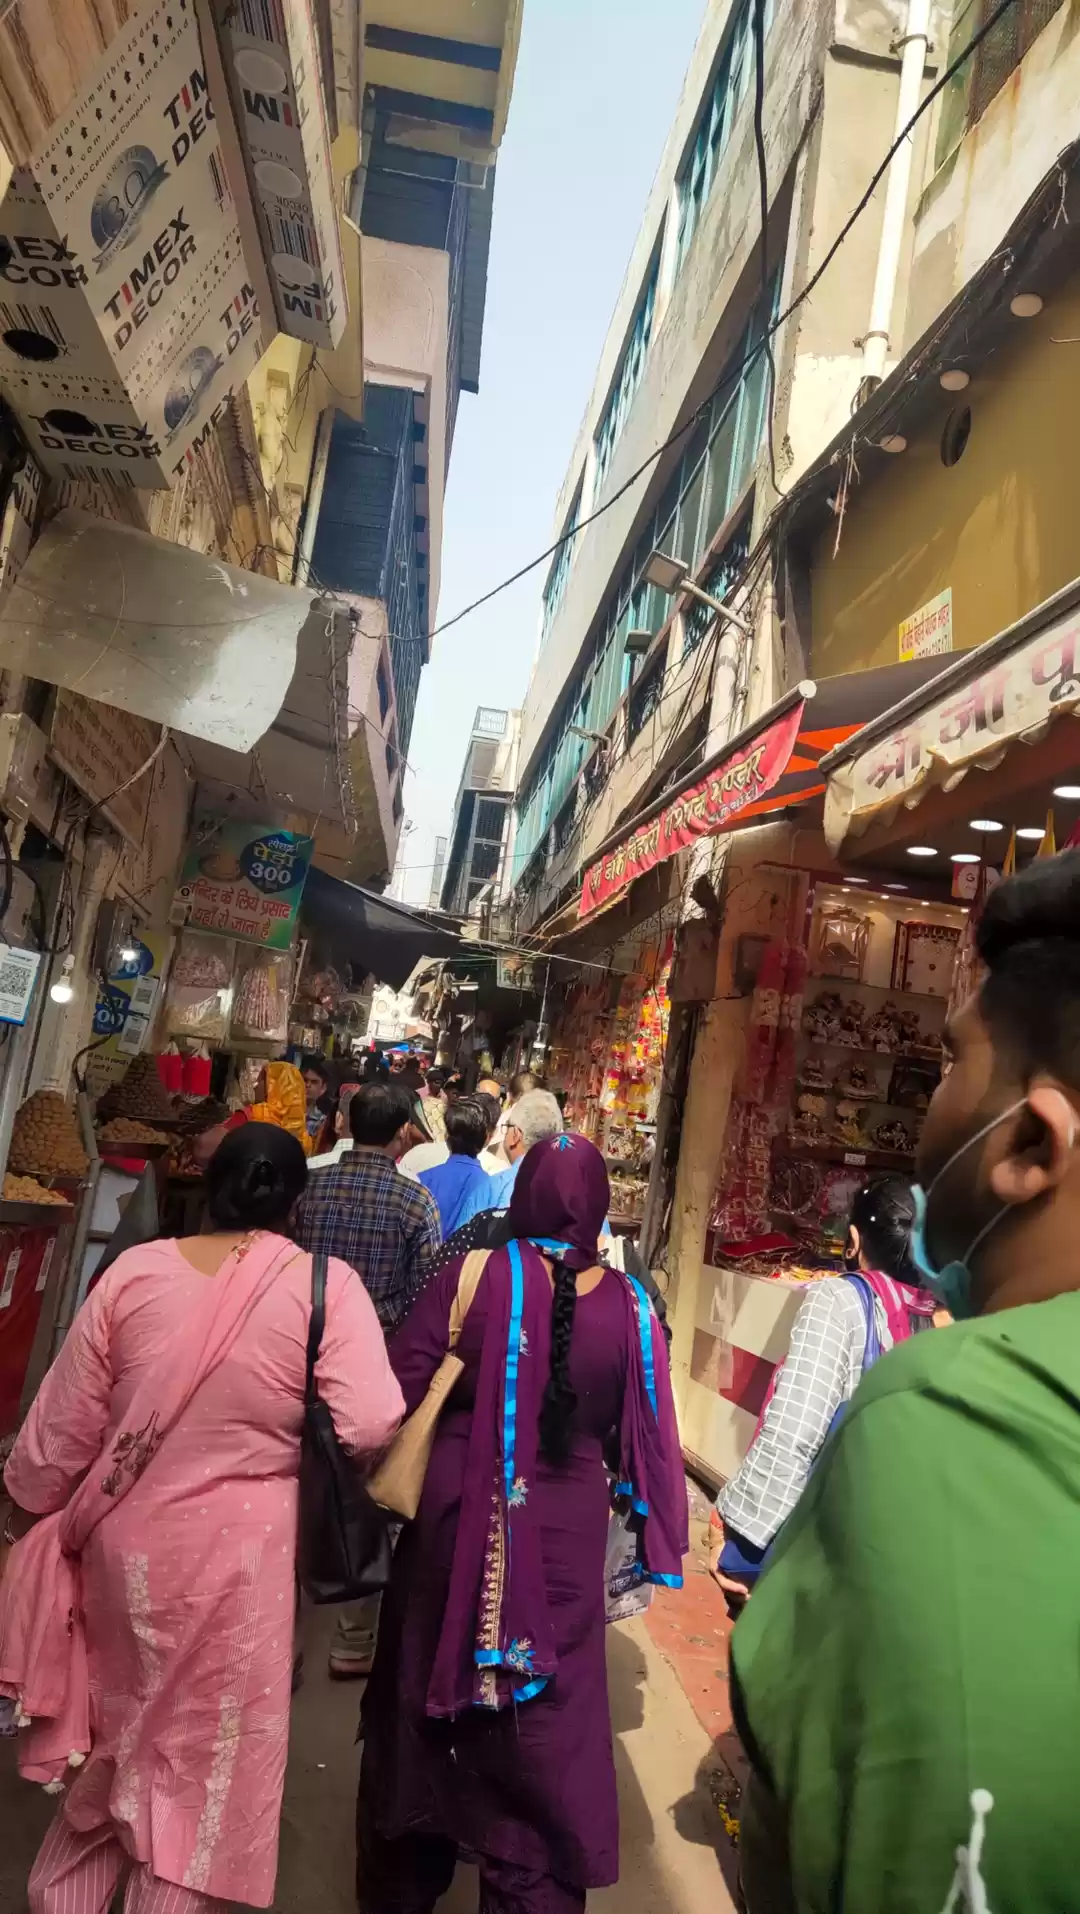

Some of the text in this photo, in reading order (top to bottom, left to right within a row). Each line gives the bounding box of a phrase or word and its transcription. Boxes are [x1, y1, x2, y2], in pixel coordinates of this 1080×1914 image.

[103, 205, 190, 321] TIMEX
[113, 235, 197, 351] DECOR
[38, 434, 162, 460] DECOR
[249, 862, 291, 884] 300
